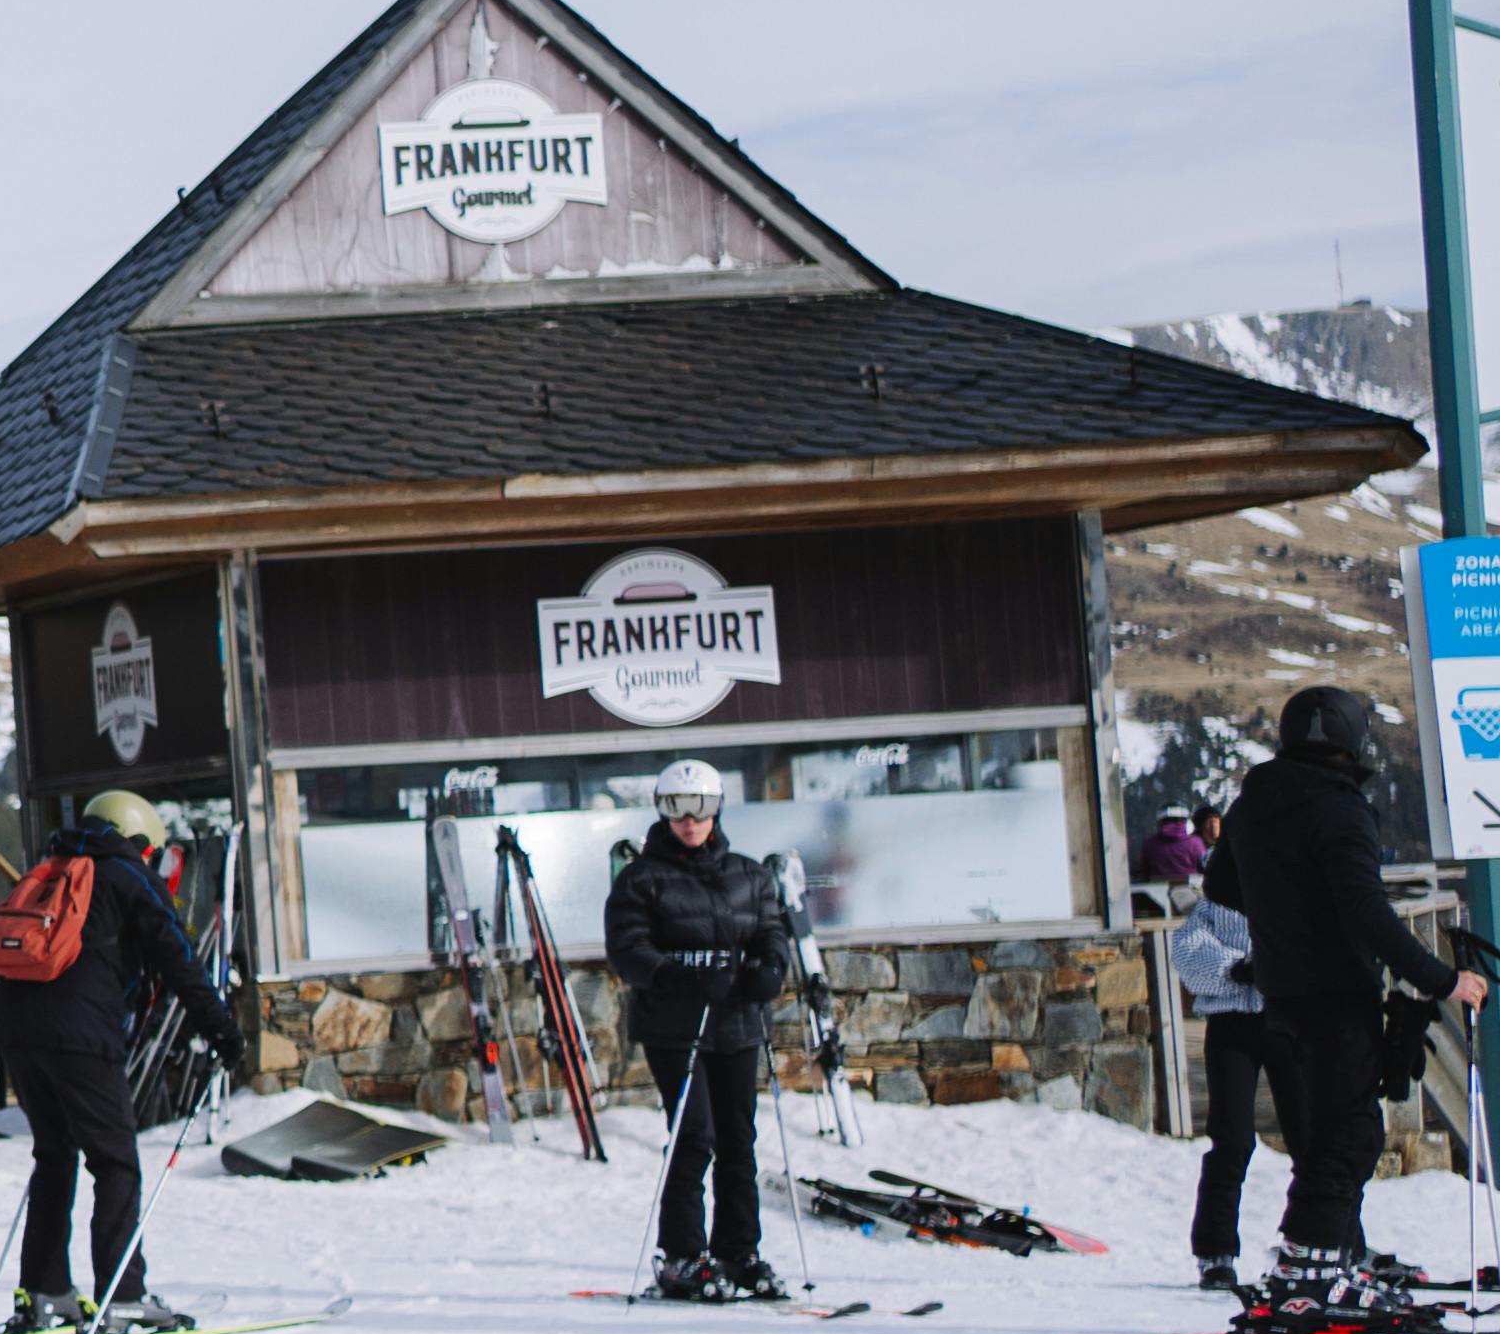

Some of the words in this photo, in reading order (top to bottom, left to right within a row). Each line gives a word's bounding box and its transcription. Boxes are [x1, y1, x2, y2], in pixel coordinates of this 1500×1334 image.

[393, 136, 594, 186] FRANKFURT
[452, 182, 535, 217] Gourmet
[1451, 569, 1500, 588] PÍCNI
[1456, 554, 1500, 571] ZONA
[1454, 605, 1500, 621] PICNI
[552, 609, 765, 668] FRANKFURT
[615, 659, 703, 701] Gourmet
